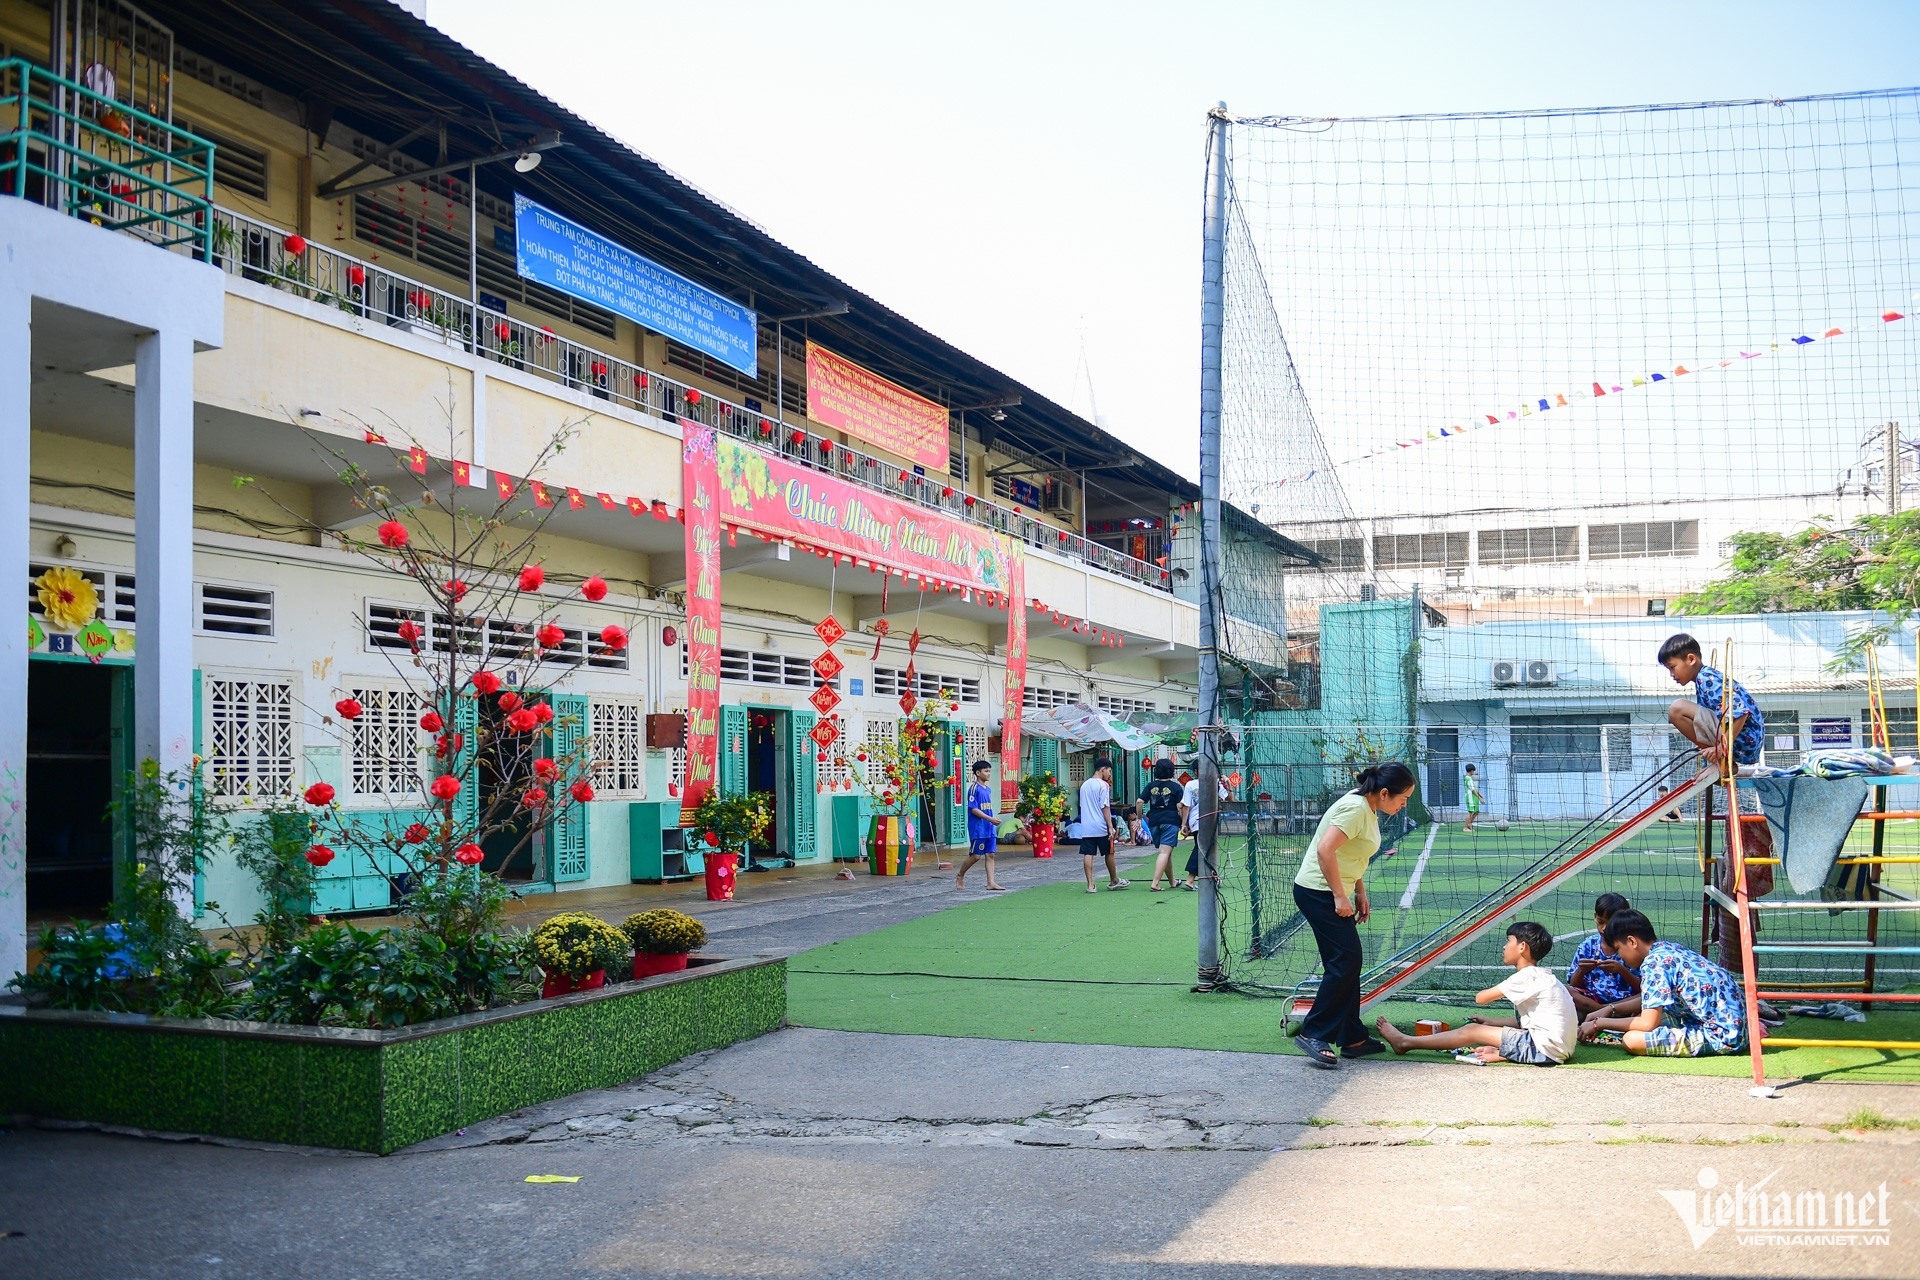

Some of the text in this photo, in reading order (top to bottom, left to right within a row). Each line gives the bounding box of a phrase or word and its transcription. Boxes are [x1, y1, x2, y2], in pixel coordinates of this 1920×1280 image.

[536, 212, 560, 233] TRUNG
[561, 225, 575, 241] TÂM
[576, 233, 596, 250] CÔNG
[597, 242, 609, 257] TÁC
[635, 261, 650, 276] GIÁO
[651, 269, 663, 283] DỤC
[664, 275, 675, 289] DẠY
[573, 245, 588, 262] TÍCH
[590, 254, 604, 269] CỰC
[605, 261, 622, 277] THAM
[624, 270, 635, 283] GIA
[634, 275, 652, 291] THỰC
[653, 284, 666, 298] HIỆN
[556, 269, 570, 284] ĐỘT
[572, 276, 586, 291] PHÁ
[587, 283, 596, 297] HẠ
[597, 286, 614, 303] TẦNG
[619, 296, 636, 313] NÂNG
[638, 305, 650, 319] CAO
[652, 312, 664, 325] HIỆU
[666, 318, 678, 332] QUẢ
[679, 323, 693, 338] PHỤC
[572, 260, 590, 278] NÂNG
[592, 270, 606, 284] CAO
[607, 276, 623, 292] CHẤT
[625, 284, 646, 303] LƯỢNG
[647, 294, 656, 307] TỔ
[656, 299, 673, 315] CHỨC
[674, 307, 682, 320] BỘ
[698, 319, 710, 332] KHAI
[692, 480, 711, 516] Lộc
[693, 524, 714, 555] Biếc
[785, 478, 974, 568] Chúc Mừng Năm Mới
[694, 570, 714, 600] Mai
[57, 636, 64, 650] 3
[690, 616, 717, 652] Vàng
[690, 706, 715, 743] Hạnh
[690, 752, 712, 787] Phúc
